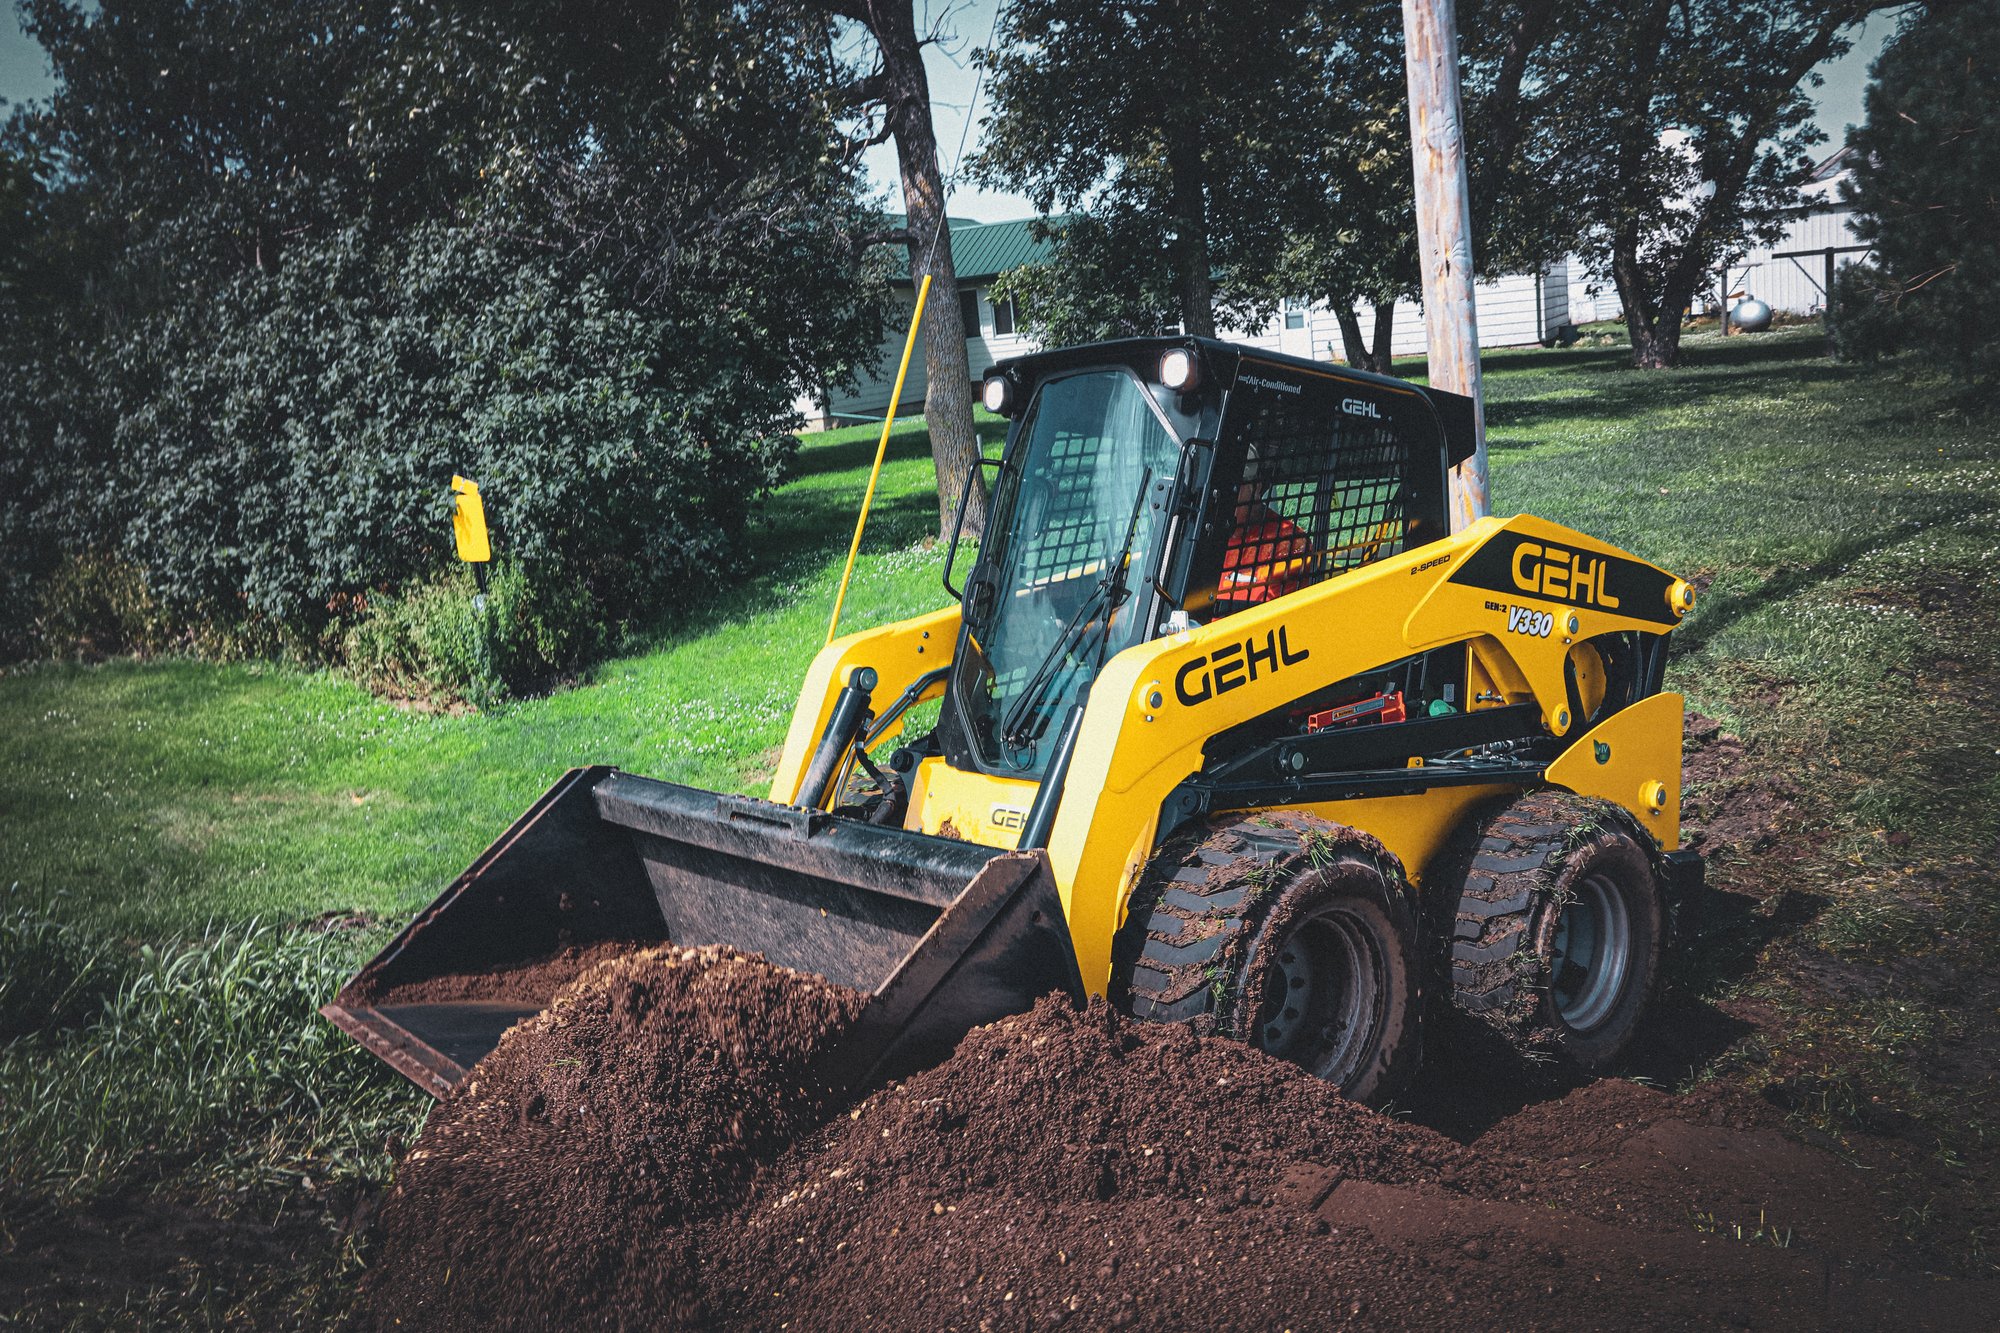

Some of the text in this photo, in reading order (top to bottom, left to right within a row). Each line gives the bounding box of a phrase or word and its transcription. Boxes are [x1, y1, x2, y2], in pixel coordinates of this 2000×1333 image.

[1249, 375, 1302, 395] Air-Conditioned
[1341, 398, 1381, 419] GEHL
[1410, 554, 1451, 575] 2-SPEED
[1511, 541, 1620, 609] GEHL
[1507, 604, 1554, 638] V330
[1175, 624, 1310, 707] GEHL
